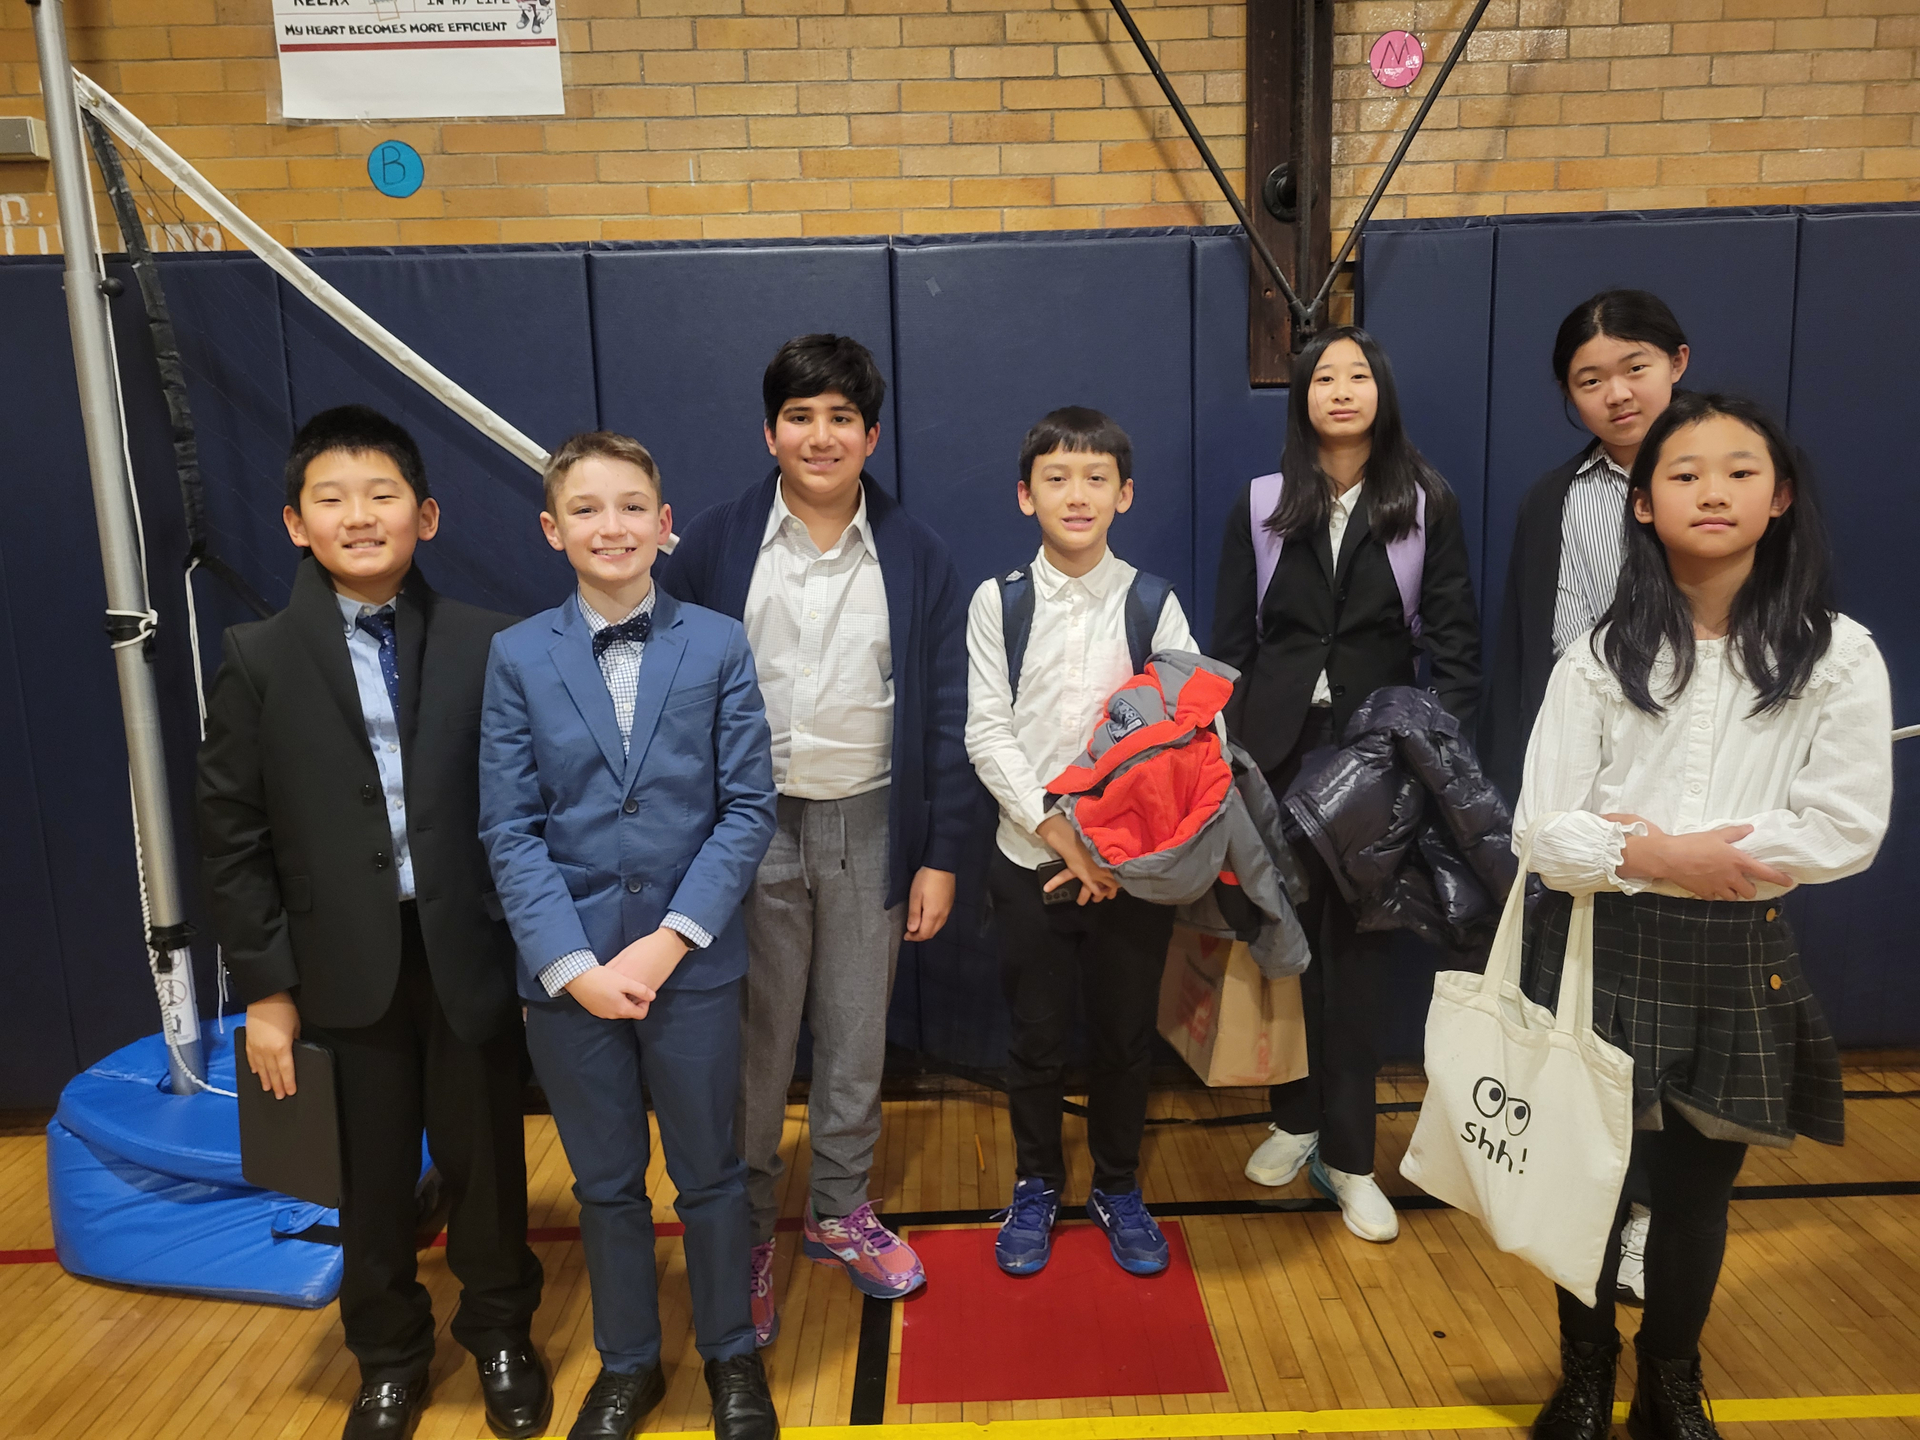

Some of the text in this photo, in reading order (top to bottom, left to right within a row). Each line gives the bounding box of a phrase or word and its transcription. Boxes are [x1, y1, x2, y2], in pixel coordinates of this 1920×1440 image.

[305, 25, 346, 36] HEART
[348, 23, 407, 35] BECOMES
[410, 22, 446, 33] MORE
[448, 21, 508, 32] EFFICIENT
[381, 145, 406, 185] B
